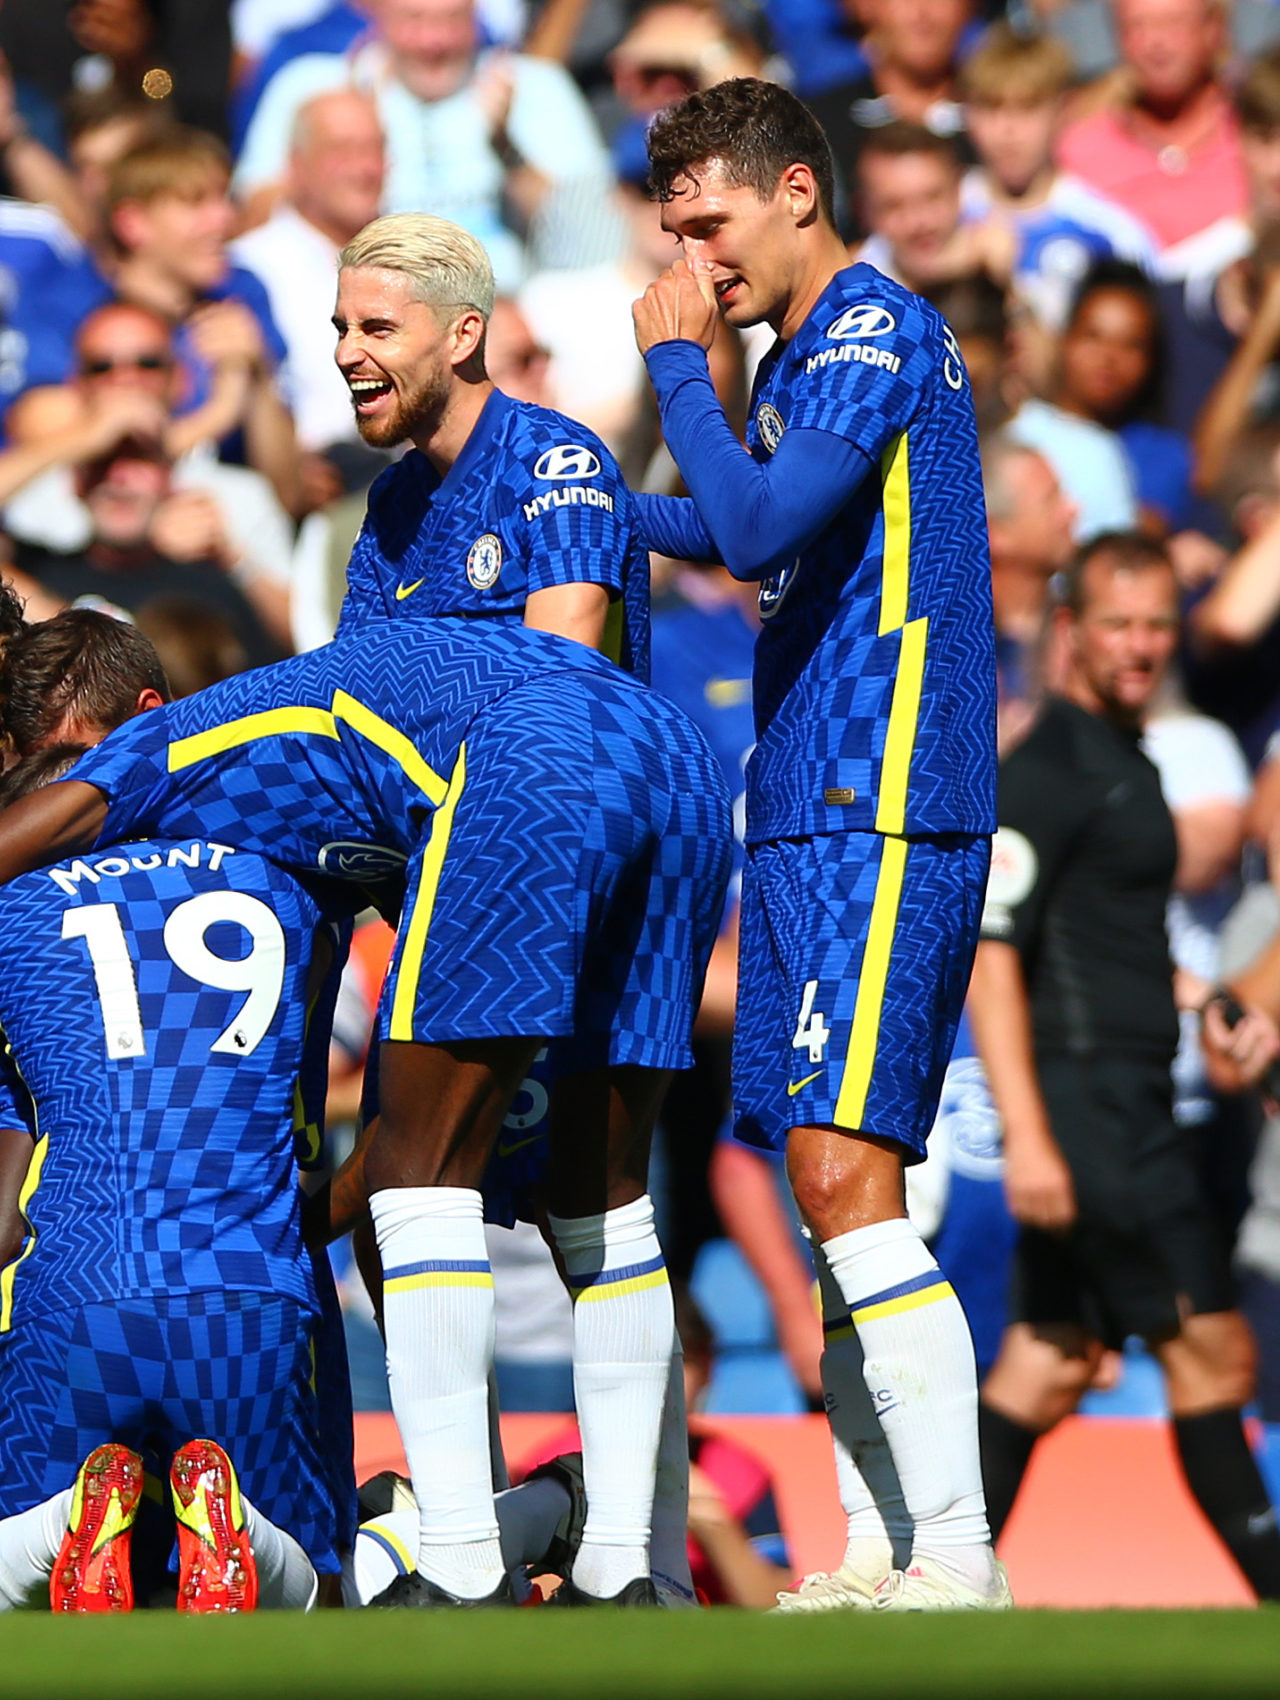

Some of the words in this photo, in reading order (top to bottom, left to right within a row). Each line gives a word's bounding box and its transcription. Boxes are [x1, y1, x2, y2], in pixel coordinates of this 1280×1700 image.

[806, 344, 901, 375] HYUNDAI
[523, 486, 614, 521] HYUNDAI
[48, 843, 235, 895] MOUNT
[61, 889, 286, 1060] 19
[792, 979, 830, 1063] 4
